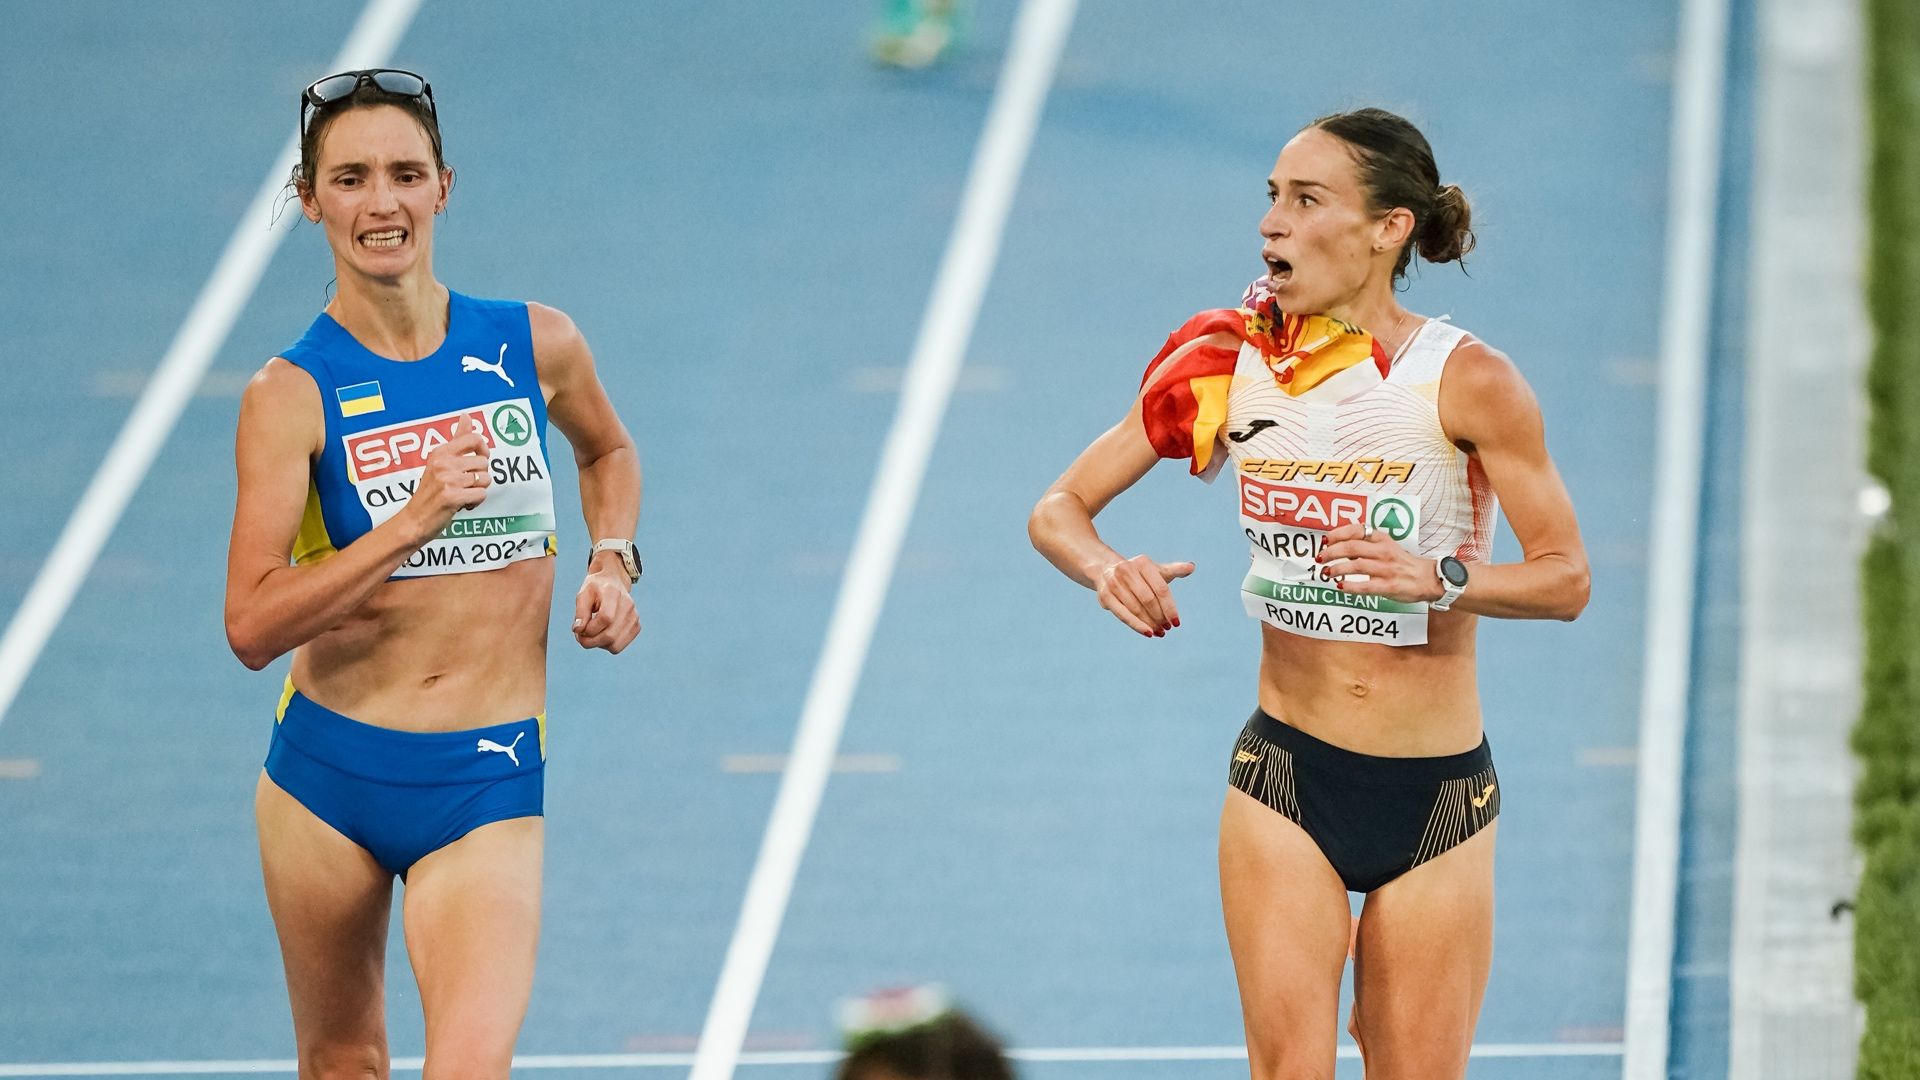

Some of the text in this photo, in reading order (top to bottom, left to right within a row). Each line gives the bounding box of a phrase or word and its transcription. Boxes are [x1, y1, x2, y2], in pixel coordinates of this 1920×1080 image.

[1239, 457, 1417, 485] ESPAÑA
[1244, 482, 1364, 529] SPAR
[402, 545, 466, 568] OMA
[1280, 586, 1319, 603] RUN
[1265, 602, 1400, 639] ROMA 2024
